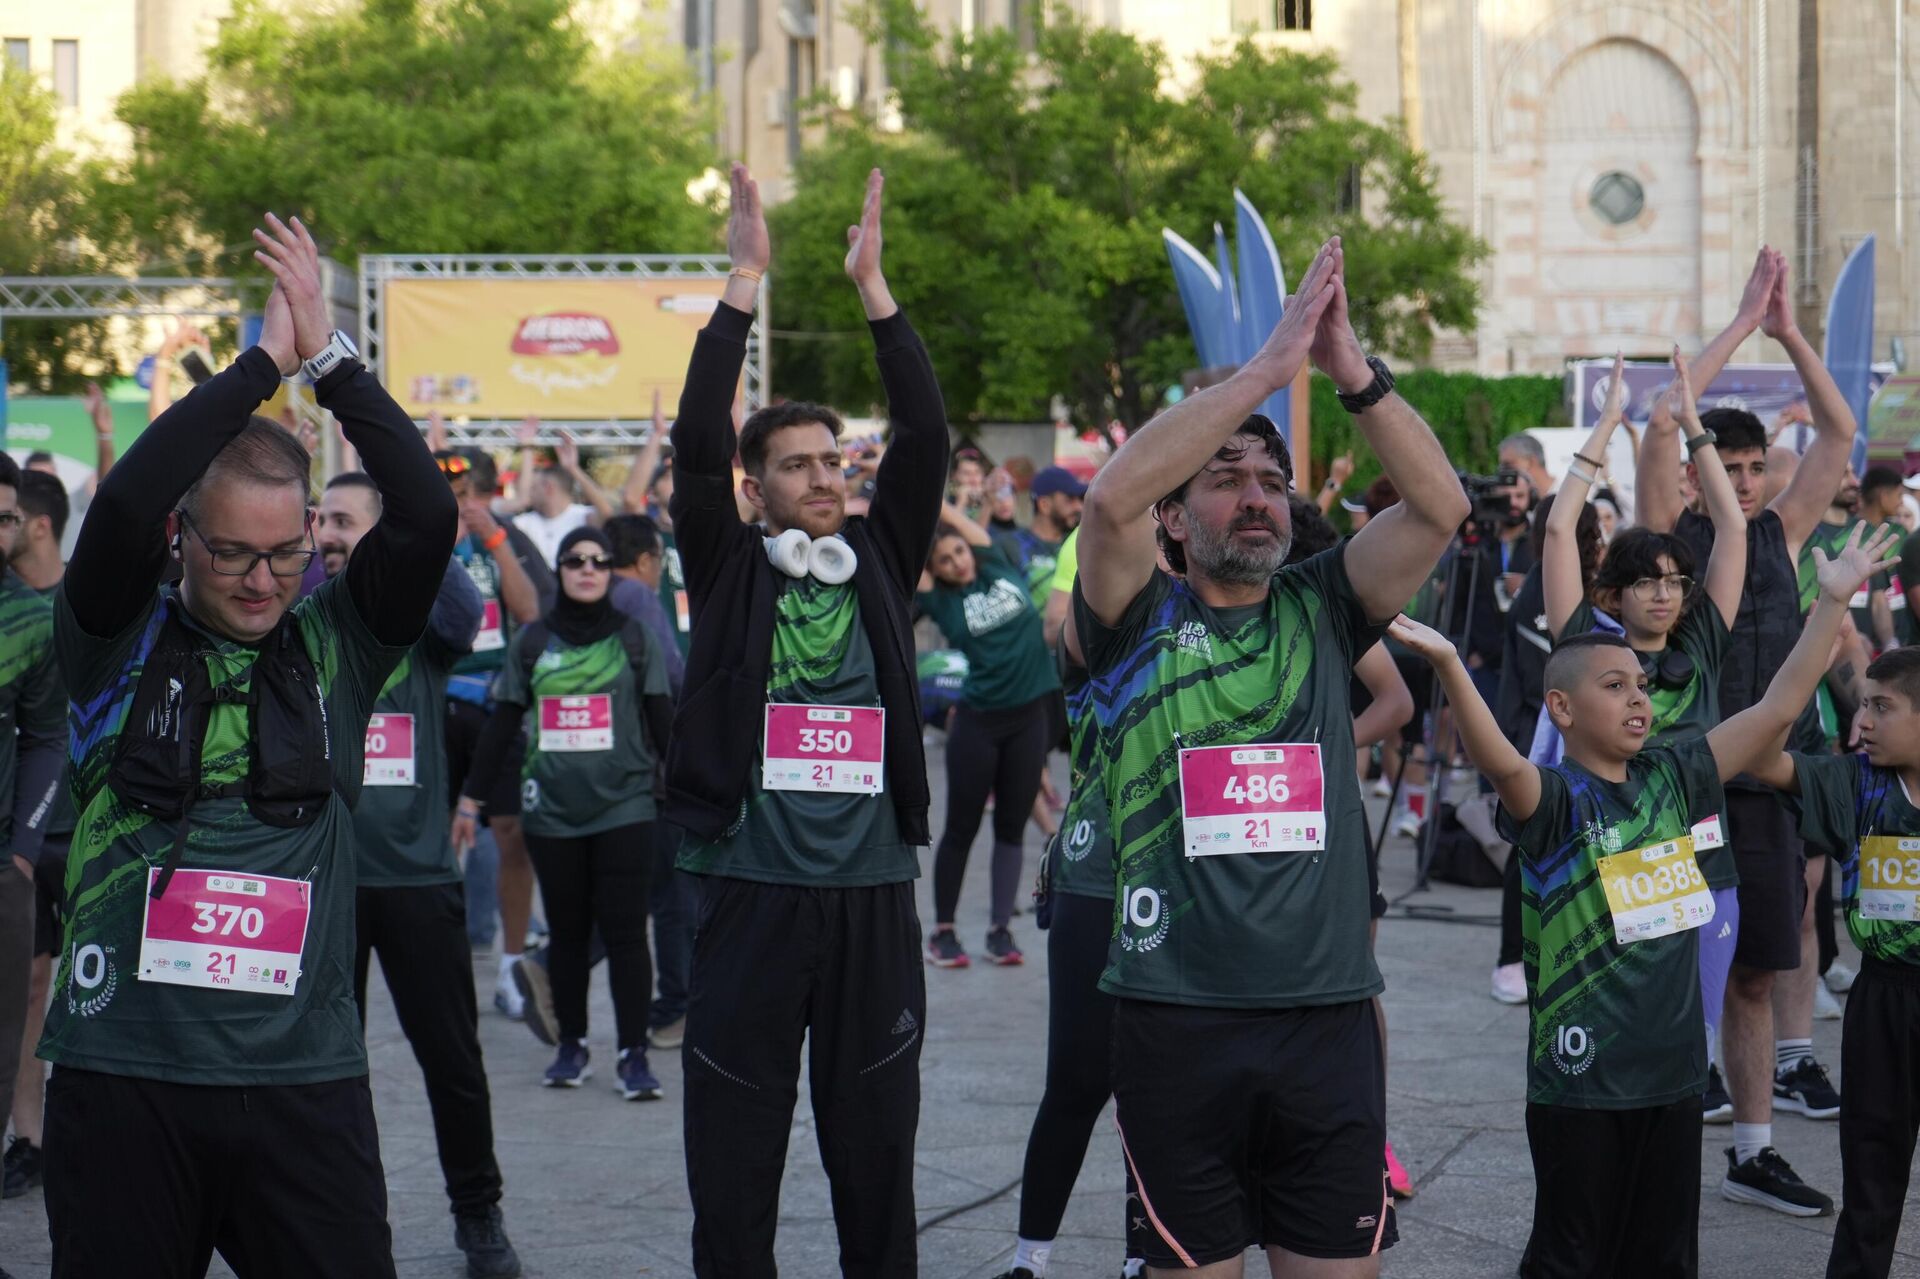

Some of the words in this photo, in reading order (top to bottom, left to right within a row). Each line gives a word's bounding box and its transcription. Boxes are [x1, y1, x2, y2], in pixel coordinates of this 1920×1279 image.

[798, 728, 852, 753] 350
[812, 765, 833, 780] 21
[816, 780, 830, 788] Km
[1223, 774, 1289, 804] 486
[1070, 819, 1090, 846] 10
[1244, 819, 1270, 839] 21
[1251, 840, 1267, 848] Km
[1611, 858, 1701, 905] 10385
[1866, 857, 1920, 886] 103
[1122, 885, 1160, 927] 10
[1673, 902, 1684, 920] 5
[191, 902, 264, 938] 370
[105, 946, 116, 954] th
[206, 952, 236, 974] 21
[212, 974, 230, 985] Km
[1558, 1025, 1587, 1057] 10
